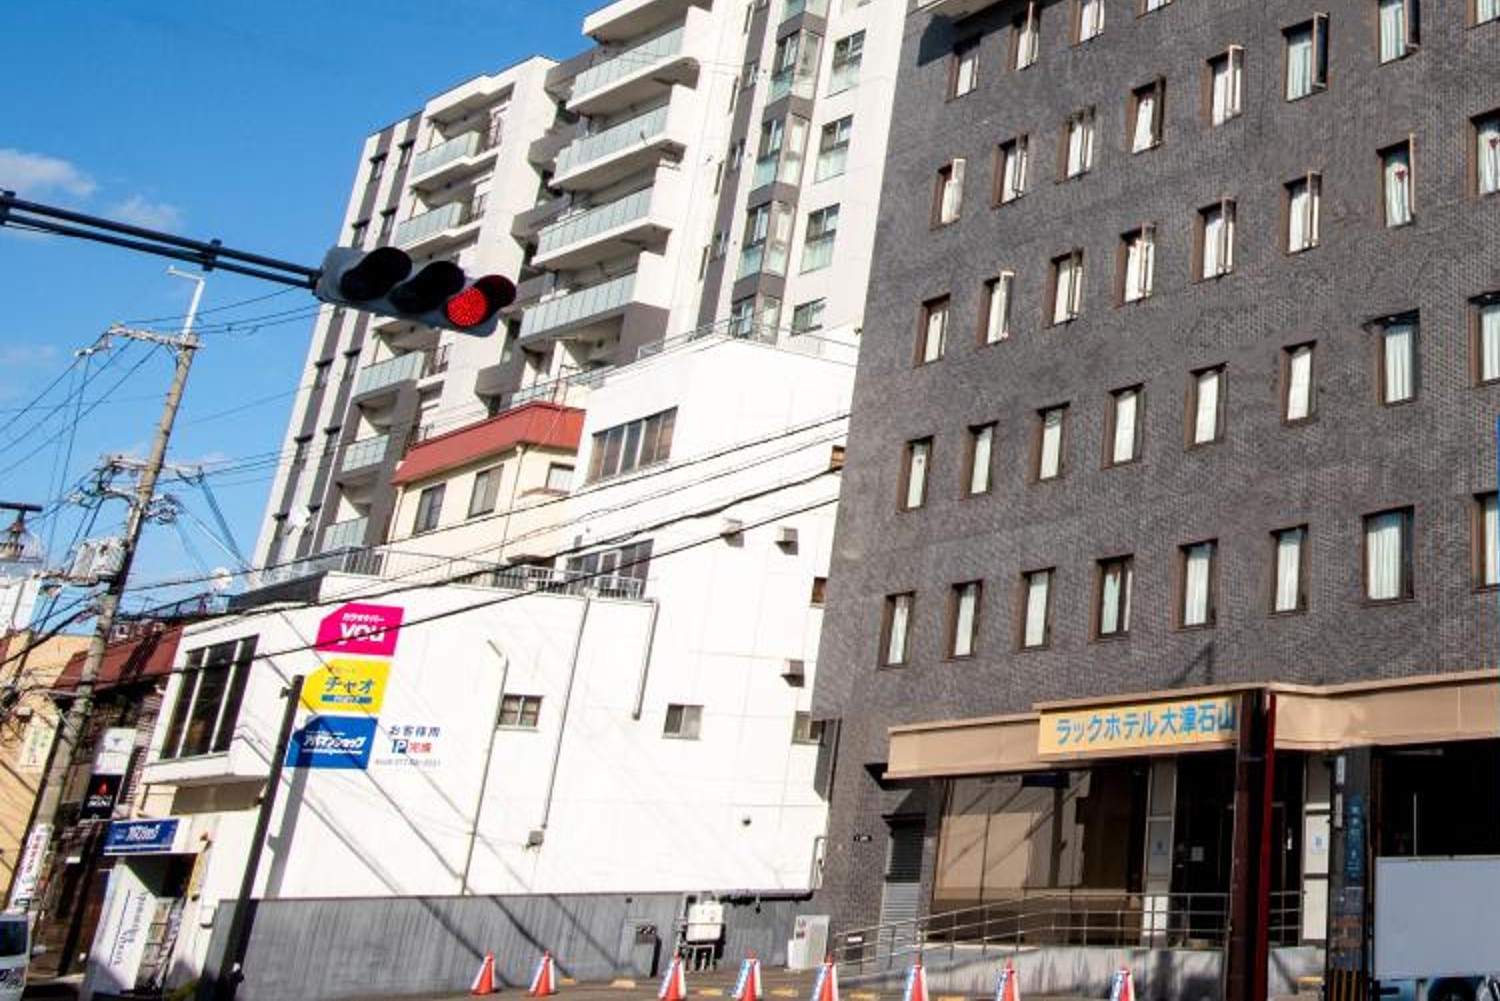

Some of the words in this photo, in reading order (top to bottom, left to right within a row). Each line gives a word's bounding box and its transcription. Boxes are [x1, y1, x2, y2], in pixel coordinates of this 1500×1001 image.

[338, 623, 386, 645] you
[325, 676, 375, 693] チャオ
[1056, 702, 1238, 746] ラックホテル大津石山
